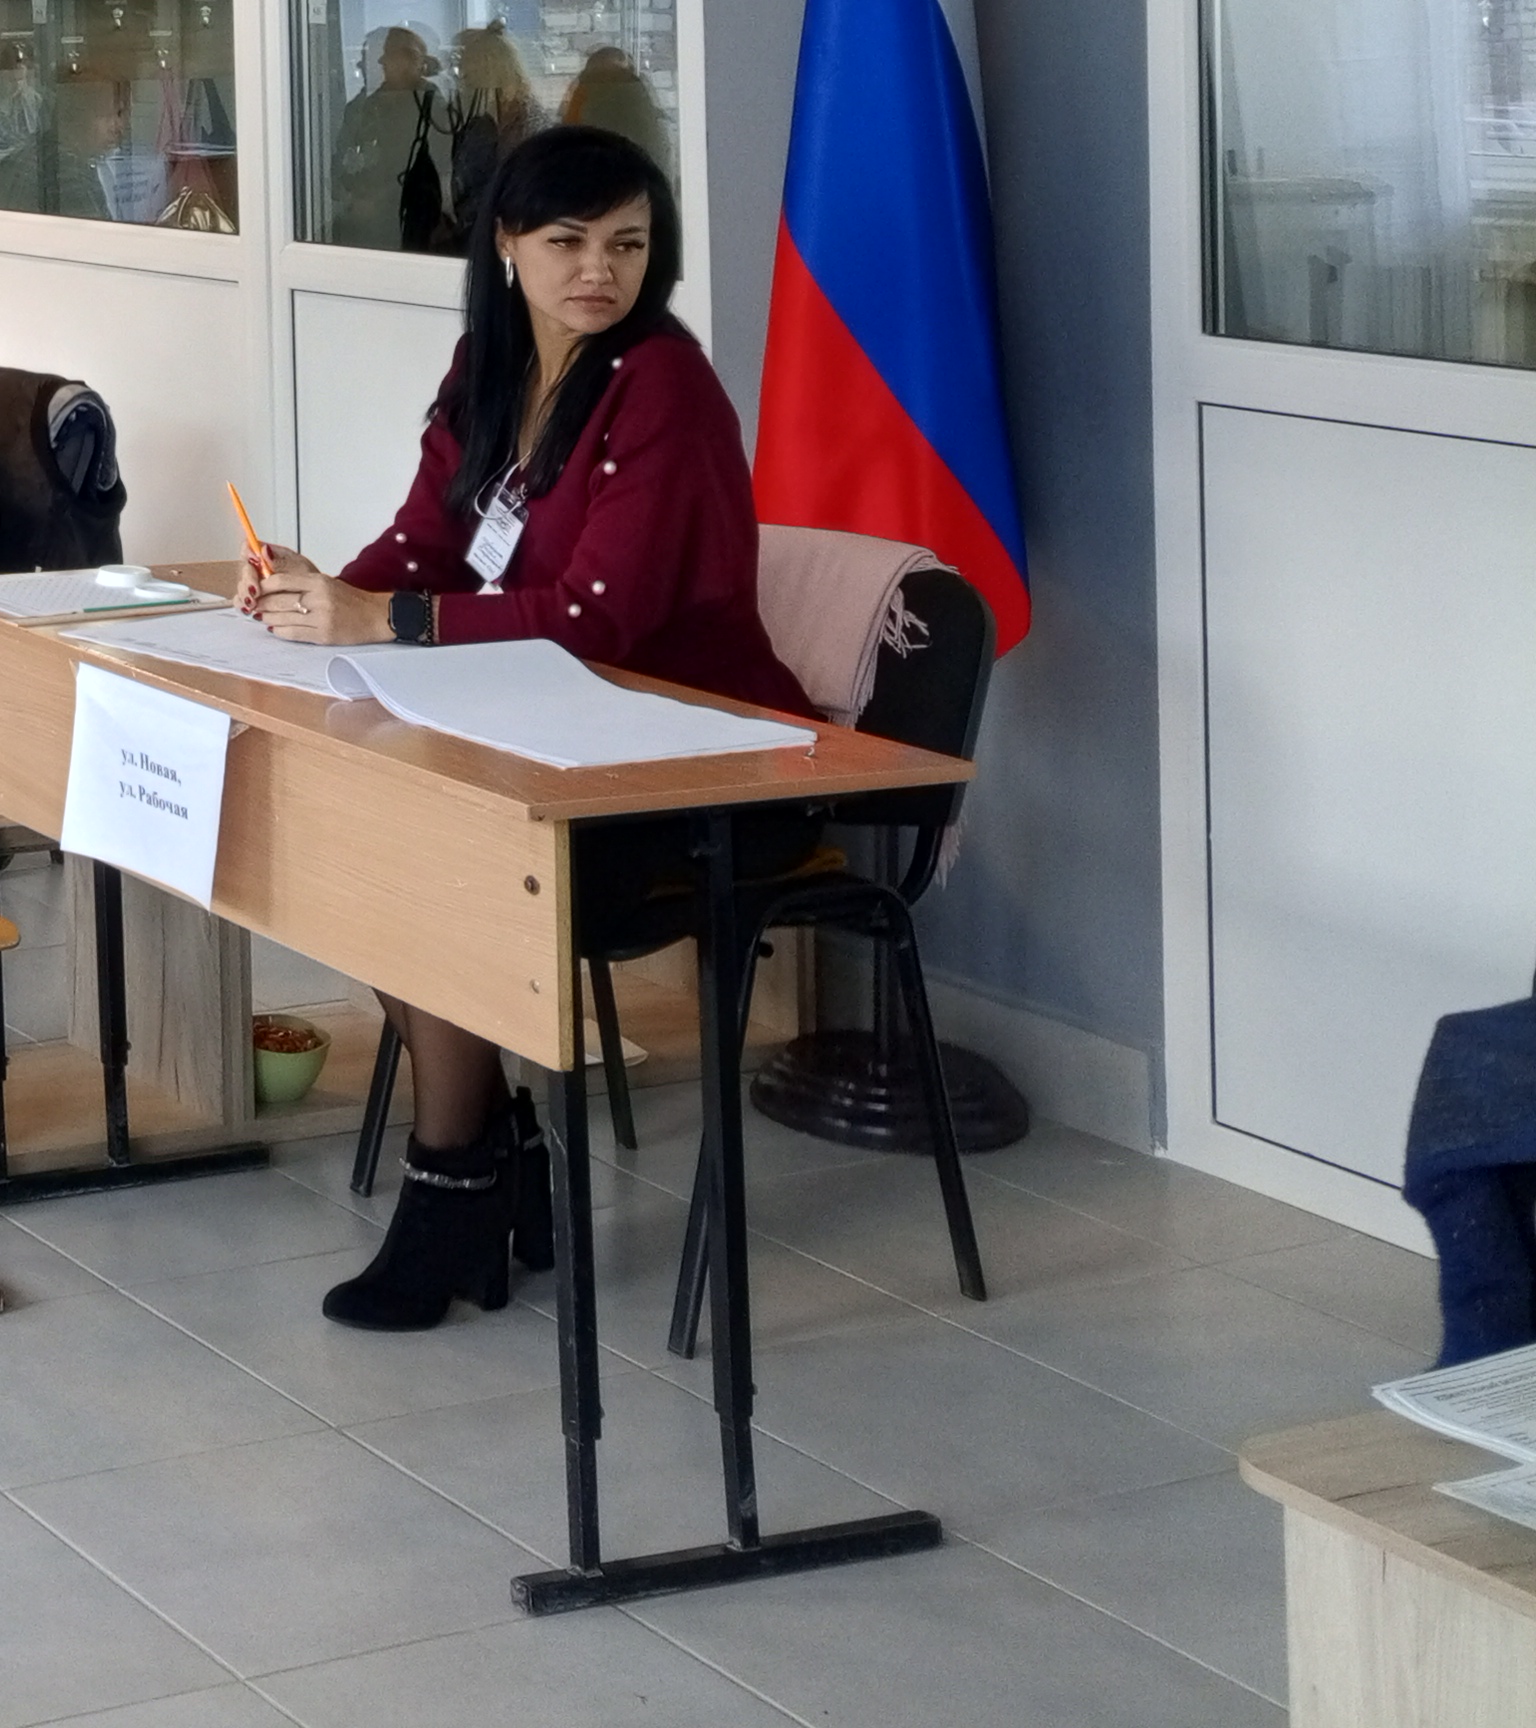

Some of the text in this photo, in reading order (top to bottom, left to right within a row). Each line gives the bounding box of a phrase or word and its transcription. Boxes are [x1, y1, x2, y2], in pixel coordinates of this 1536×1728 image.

[120, 747, 182, 787] ул. Новая,
[118, 779, 189, 821] ул. Рабочая
